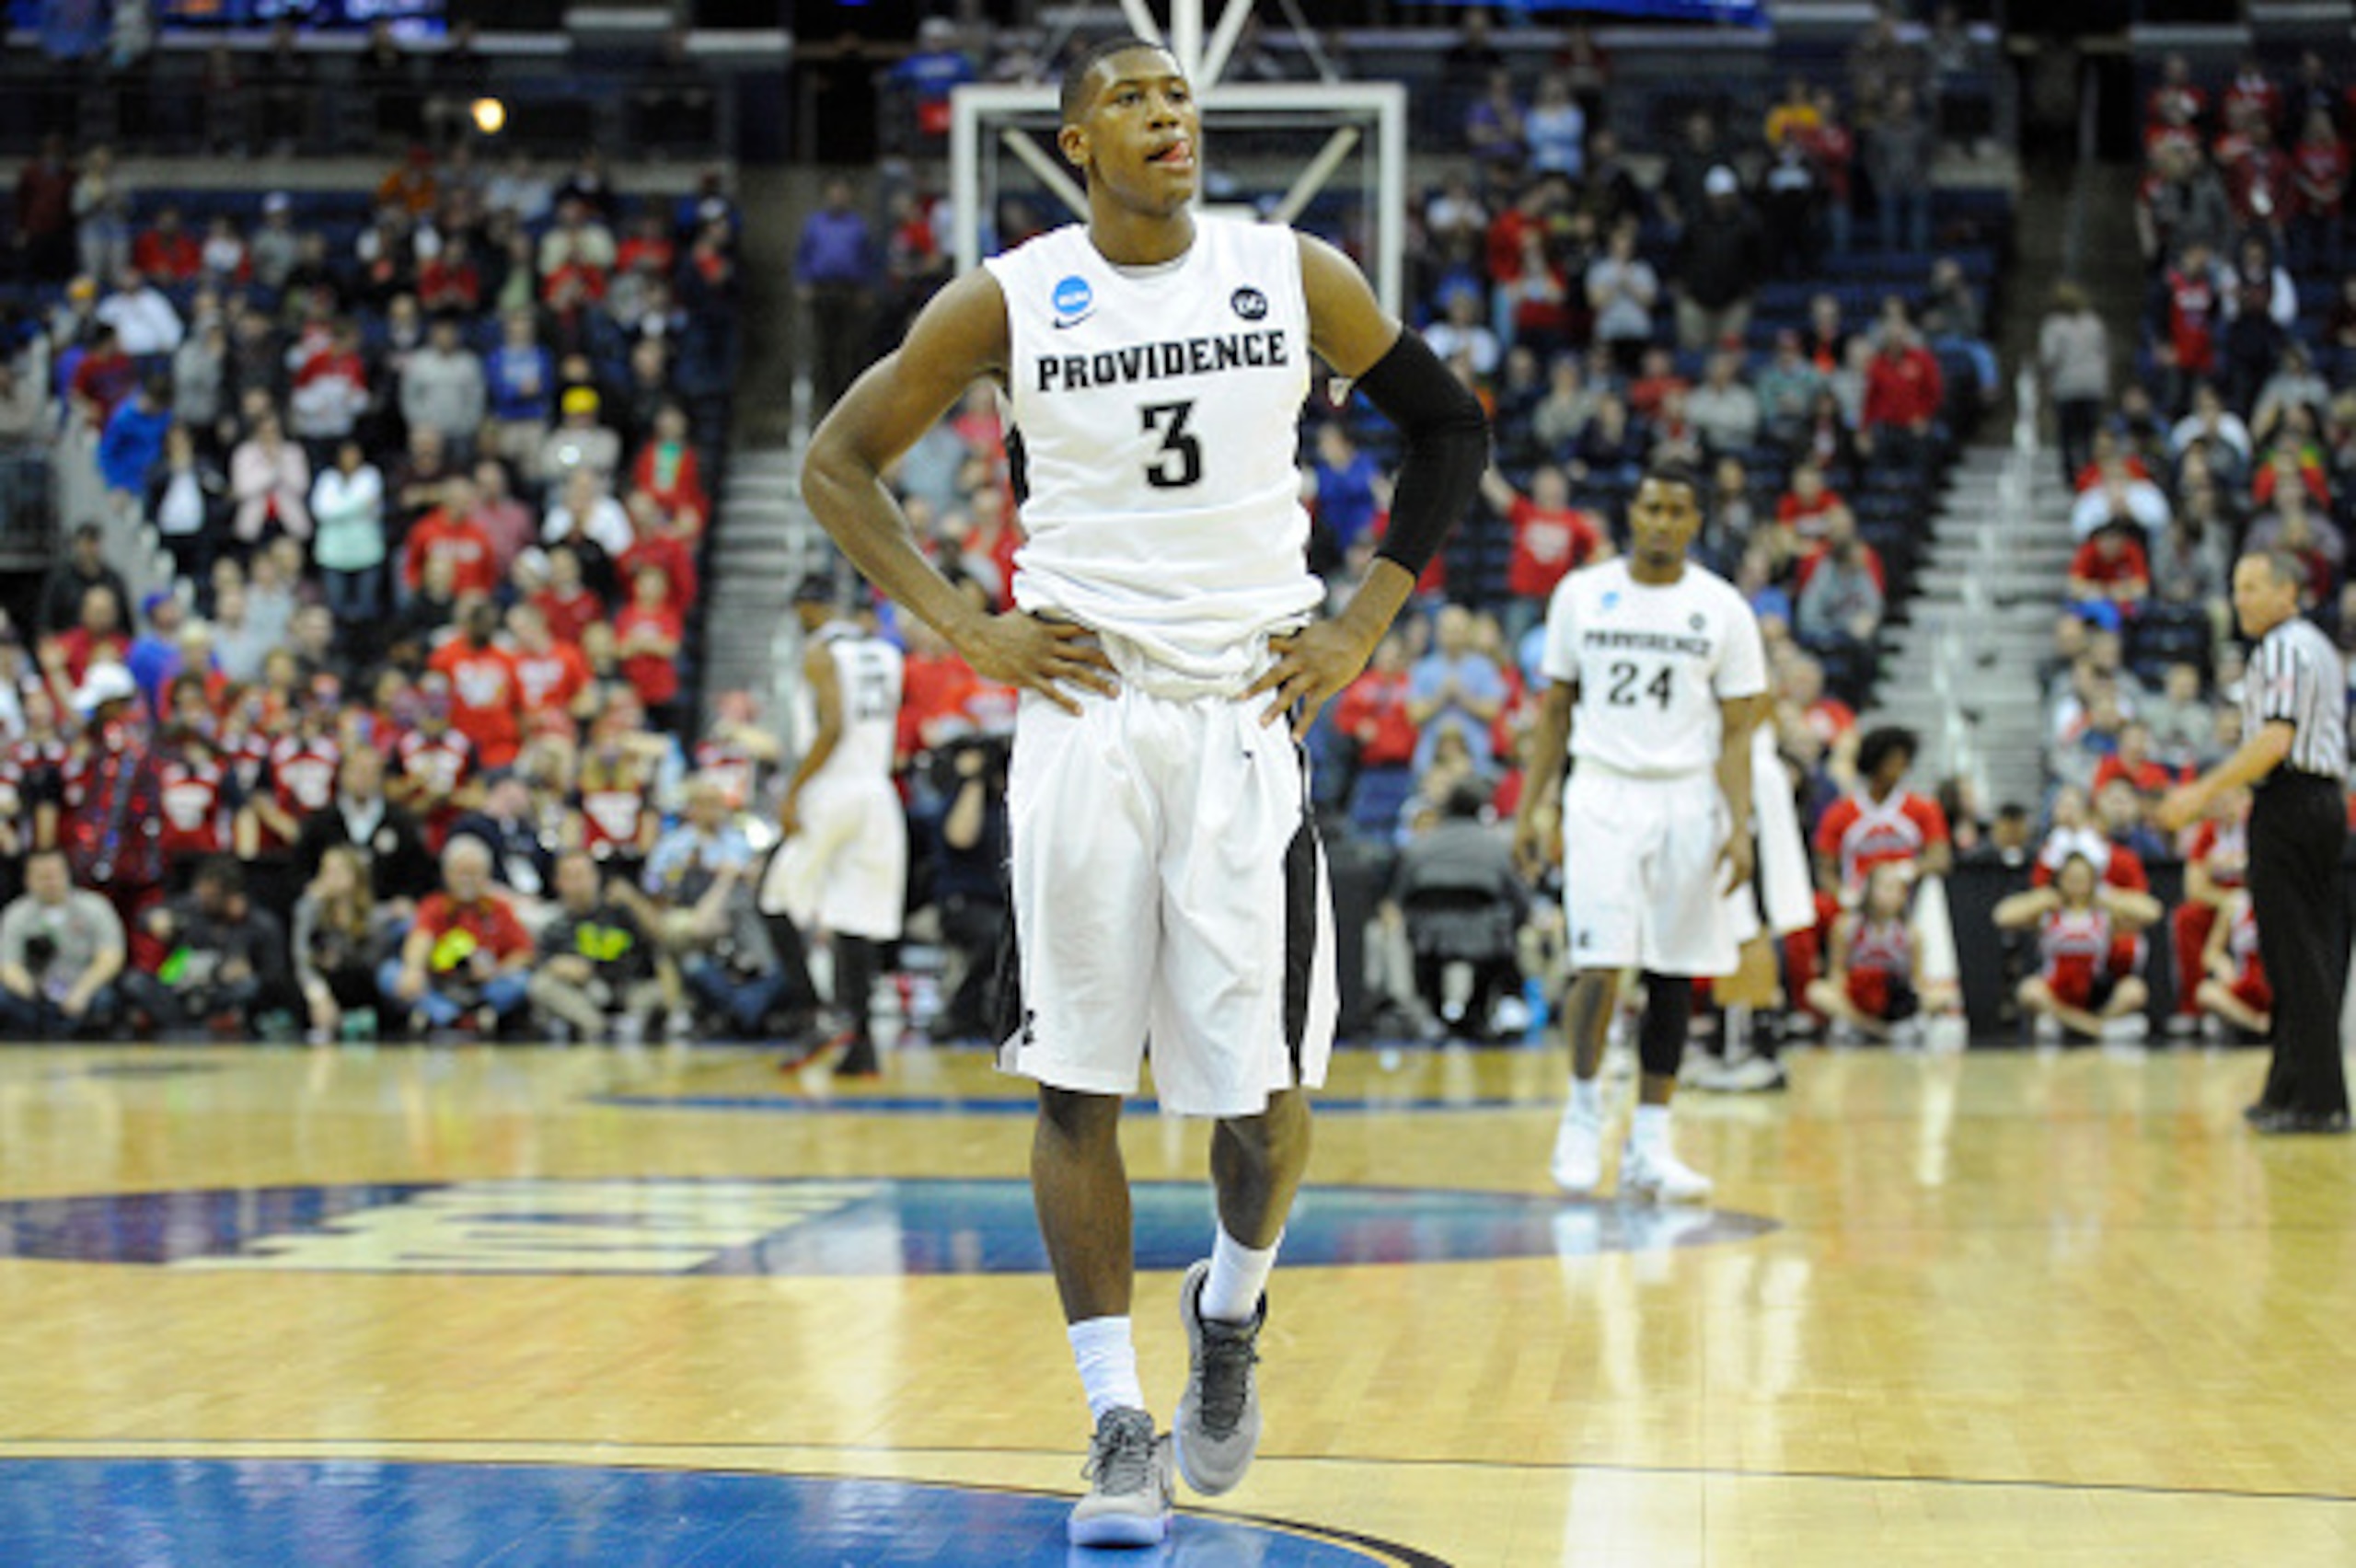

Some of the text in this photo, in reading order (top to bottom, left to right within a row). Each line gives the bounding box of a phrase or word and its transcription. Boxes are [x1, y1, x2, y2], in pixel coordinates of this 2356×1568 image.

[1037, 330, 1288, 391] PROVIDENCE
[1139, 401, 1202, 488] 3
[1608, 662, 1673, 710] 24
